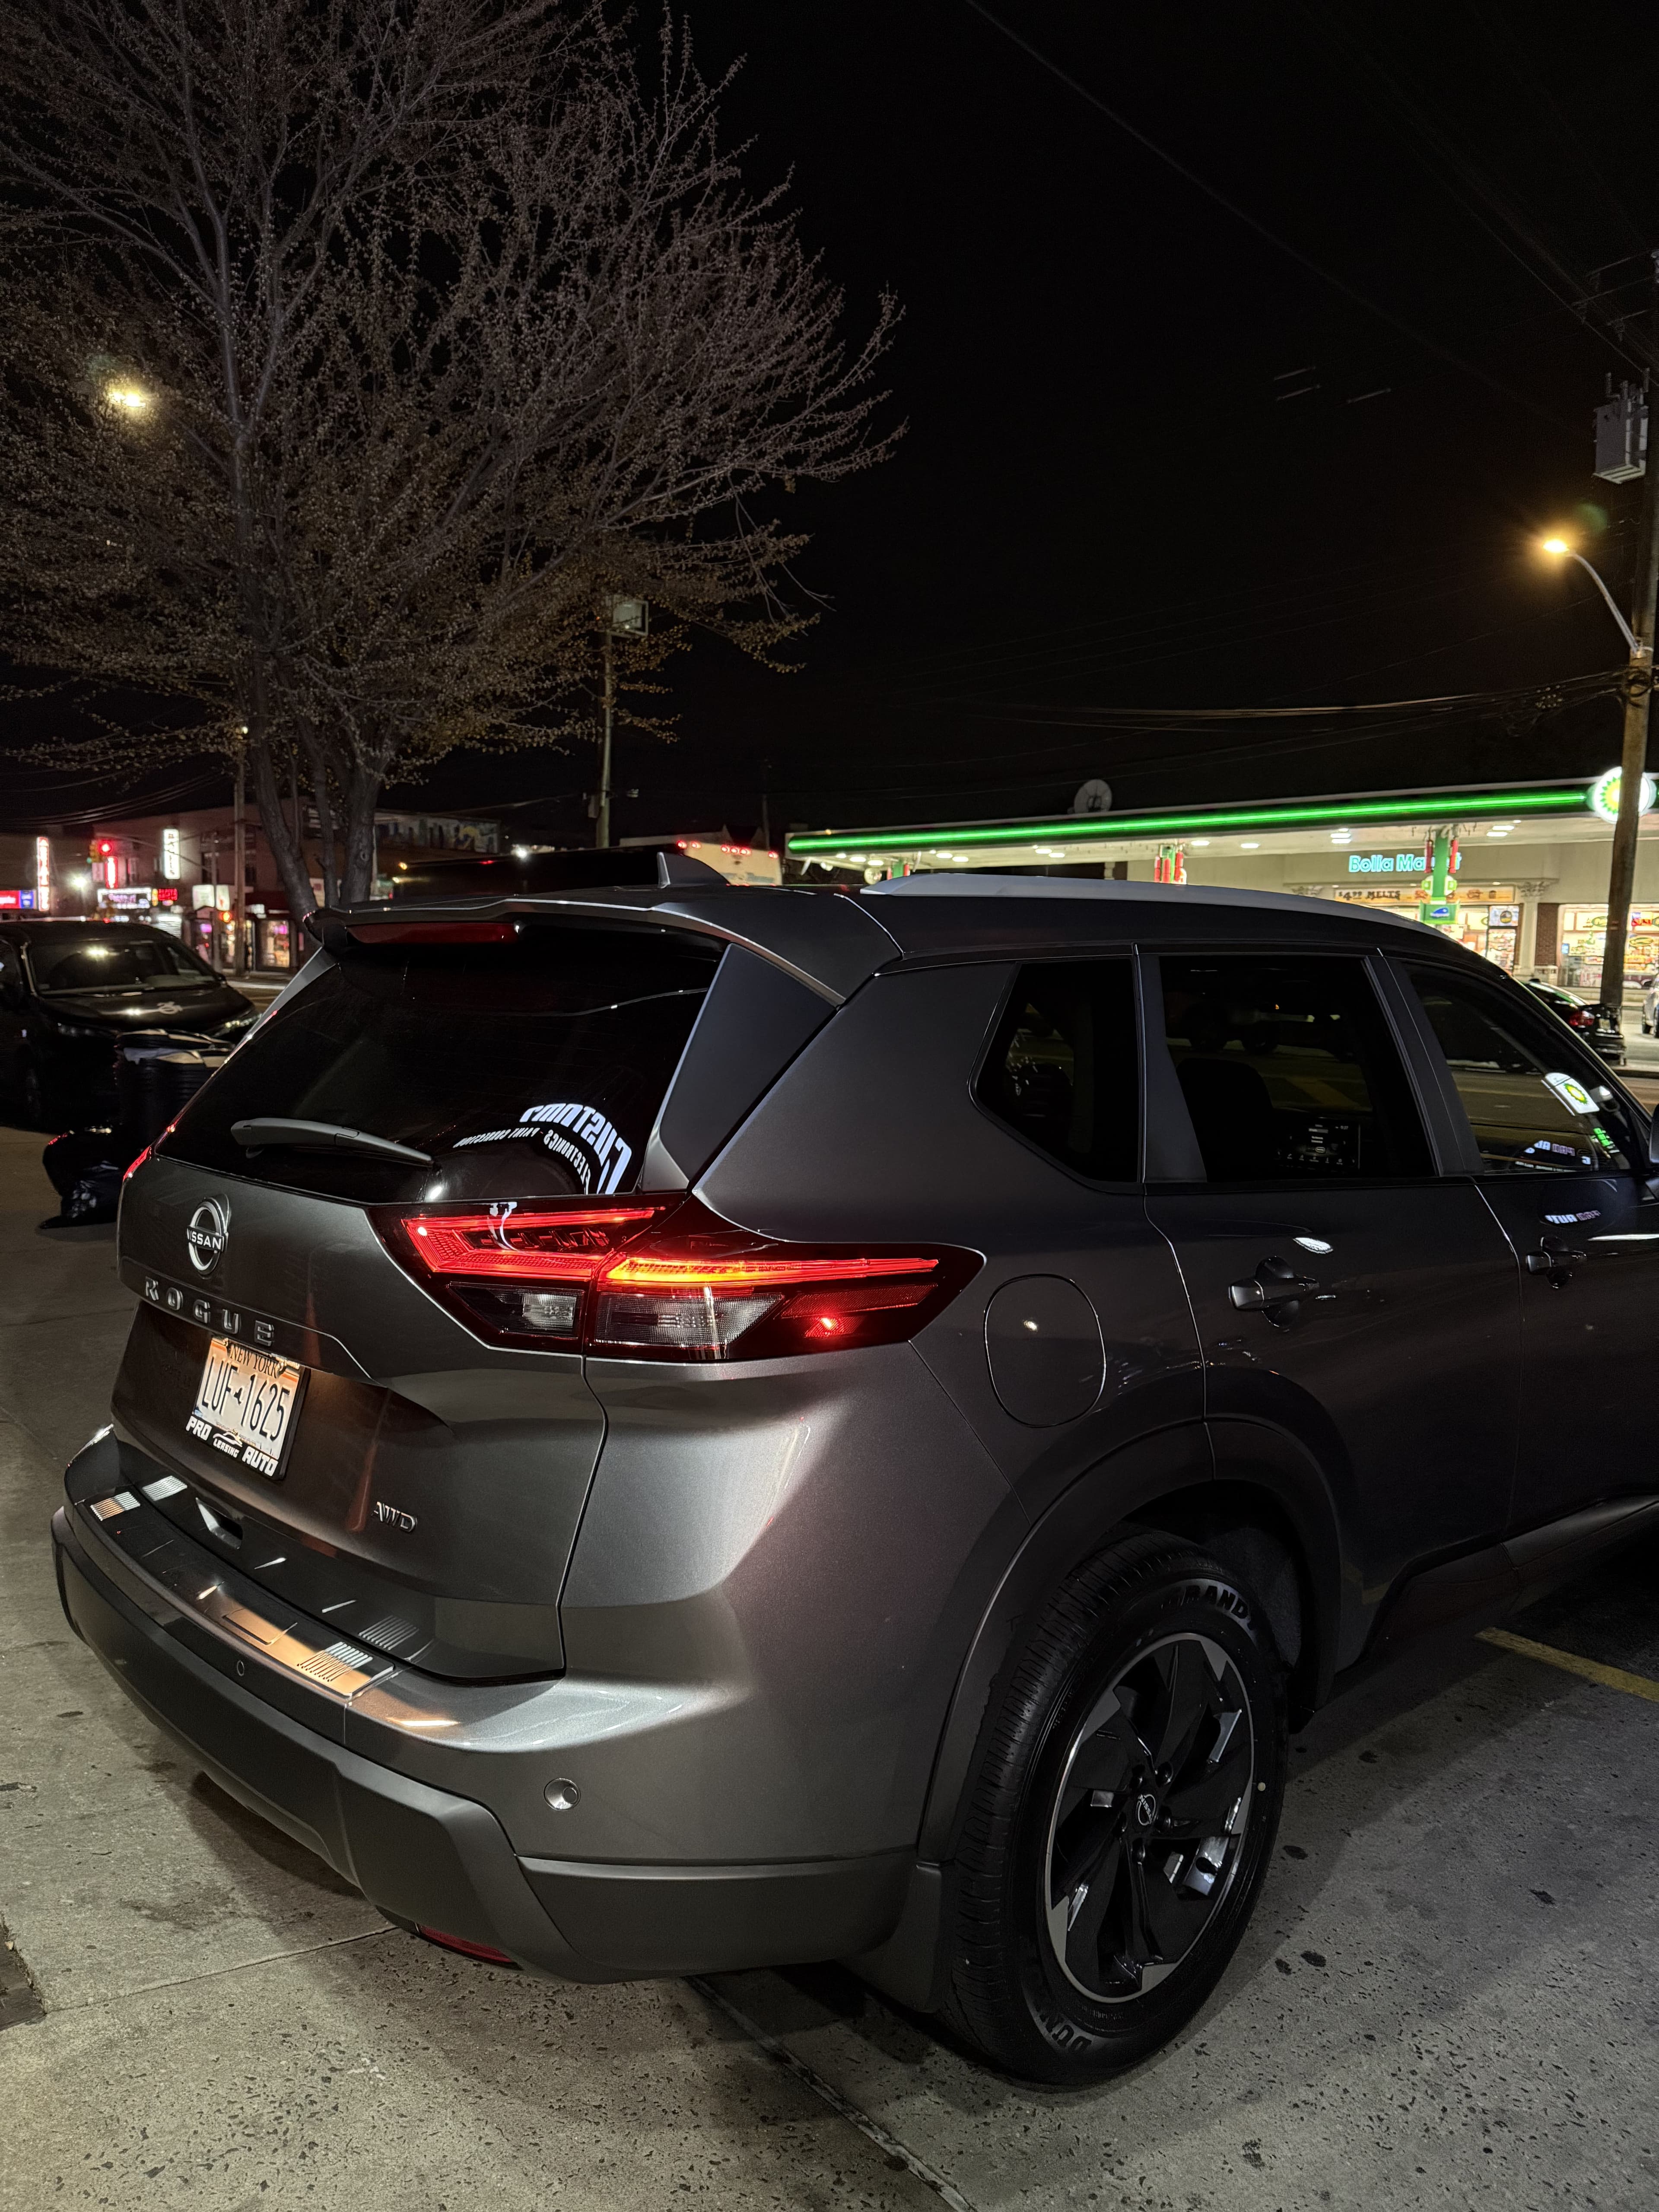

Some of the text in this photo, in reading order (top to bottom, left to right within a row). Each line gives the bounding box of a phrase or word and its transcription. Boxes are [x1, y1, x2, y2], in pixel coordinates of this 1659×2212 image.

[1348, 854, 1394, 873] Bolla
[1365, 890, 1401, 901] MELTS
[187, 1228, 222, 1250] NISSAN
[145, 1276, 275, 1347] ROGUE
[230, 1345, 253, 1367] NEW
[253, 1355, 278, 1379] YORK
[202, 1356, 290, 1441] LUF 1625
[186, 1416, 212, 1441] PRO
[213, 1439, 239, 1458] LEASING
[242, 1446, 279, 1477] AUTO
[371, 1501, 418, 1532] AWD
